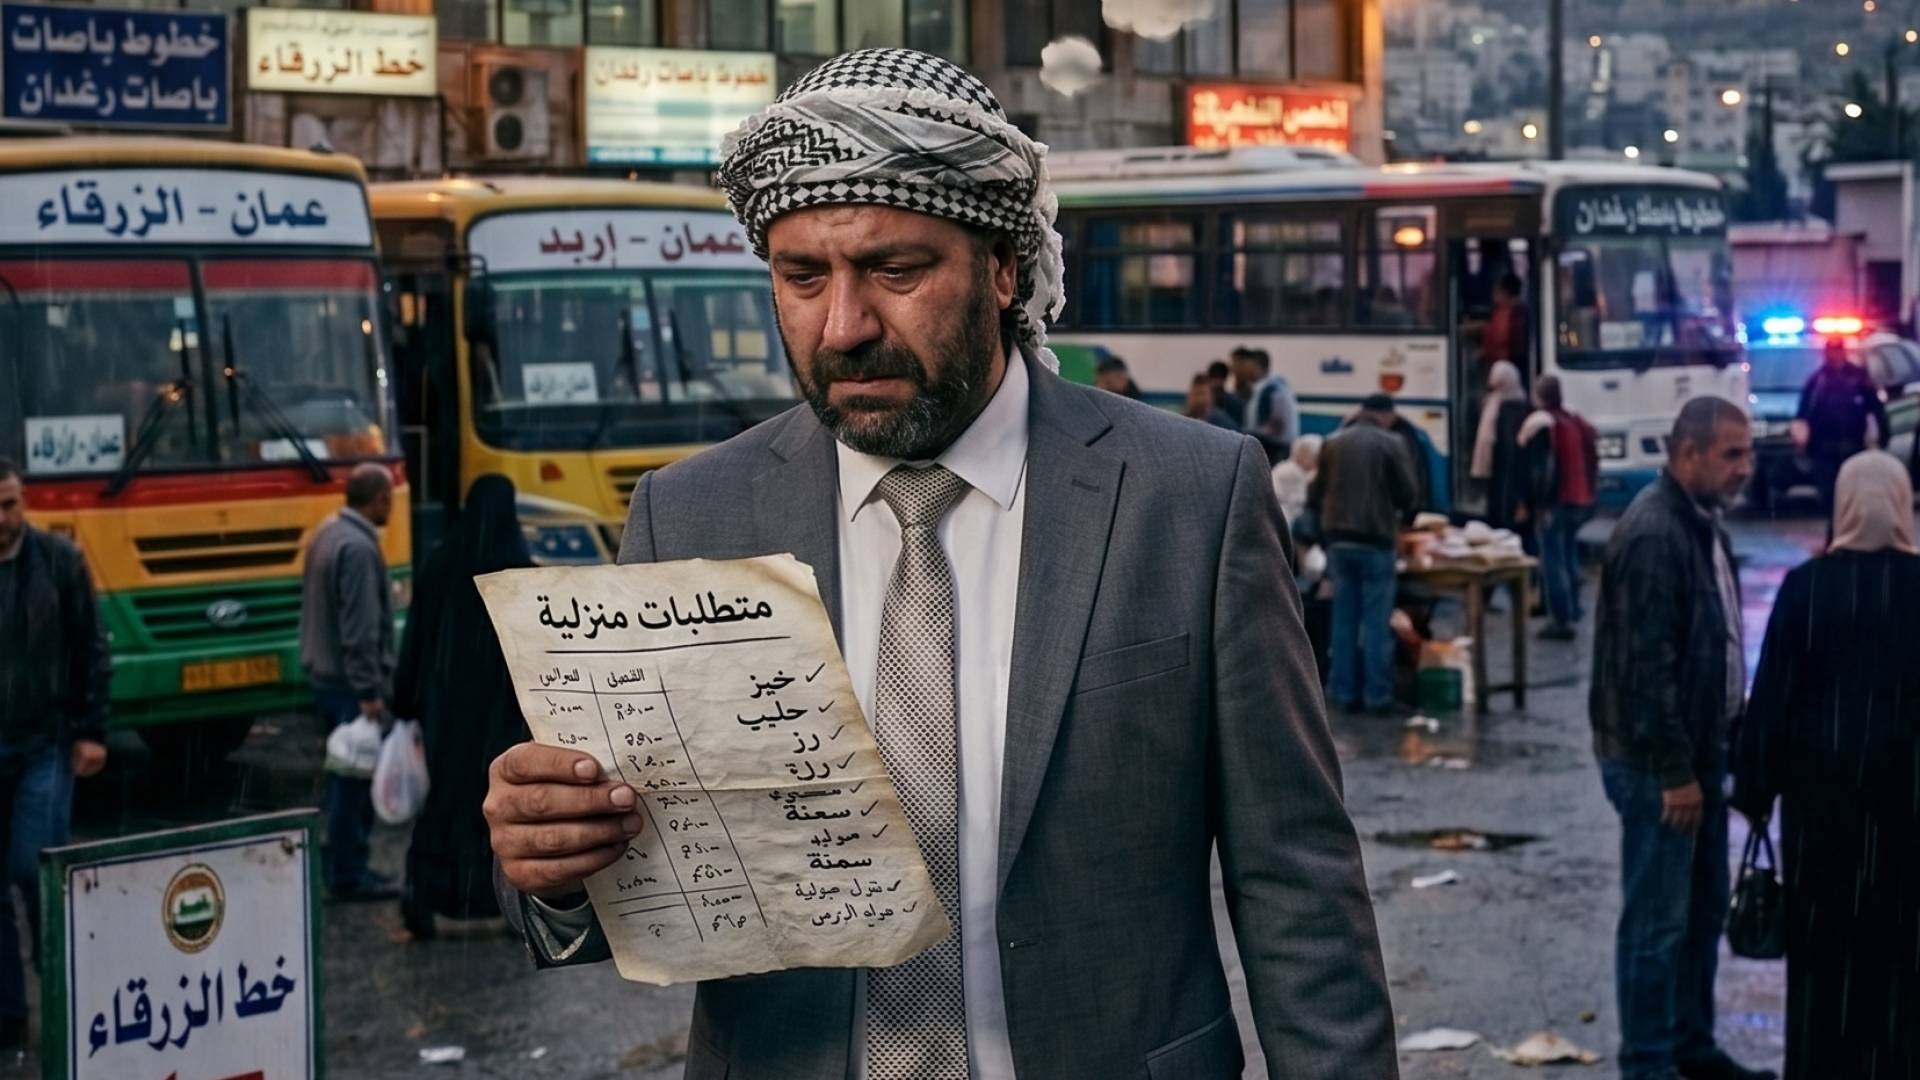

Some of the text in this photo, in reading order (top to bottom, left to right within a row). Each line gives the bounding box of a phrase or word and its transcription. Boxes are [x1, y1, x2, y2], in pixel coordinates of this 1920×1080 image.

[12, 14, 219, 66] خطوط باصات
[258, 42, 426, 83] خط الزرقاء
[19, 69, 218, 121] باصات رغدان
[37, 180, 184, 238] الزرقاء
[231, 188, 328, 237] عمان
[539, 221, 618, 269] إربد
[660, 222, 746, 262] عمان
[536, 591, 773, 639] متطلبات منزلية
[88, 955, 296, 1060] خط الزرقاء
